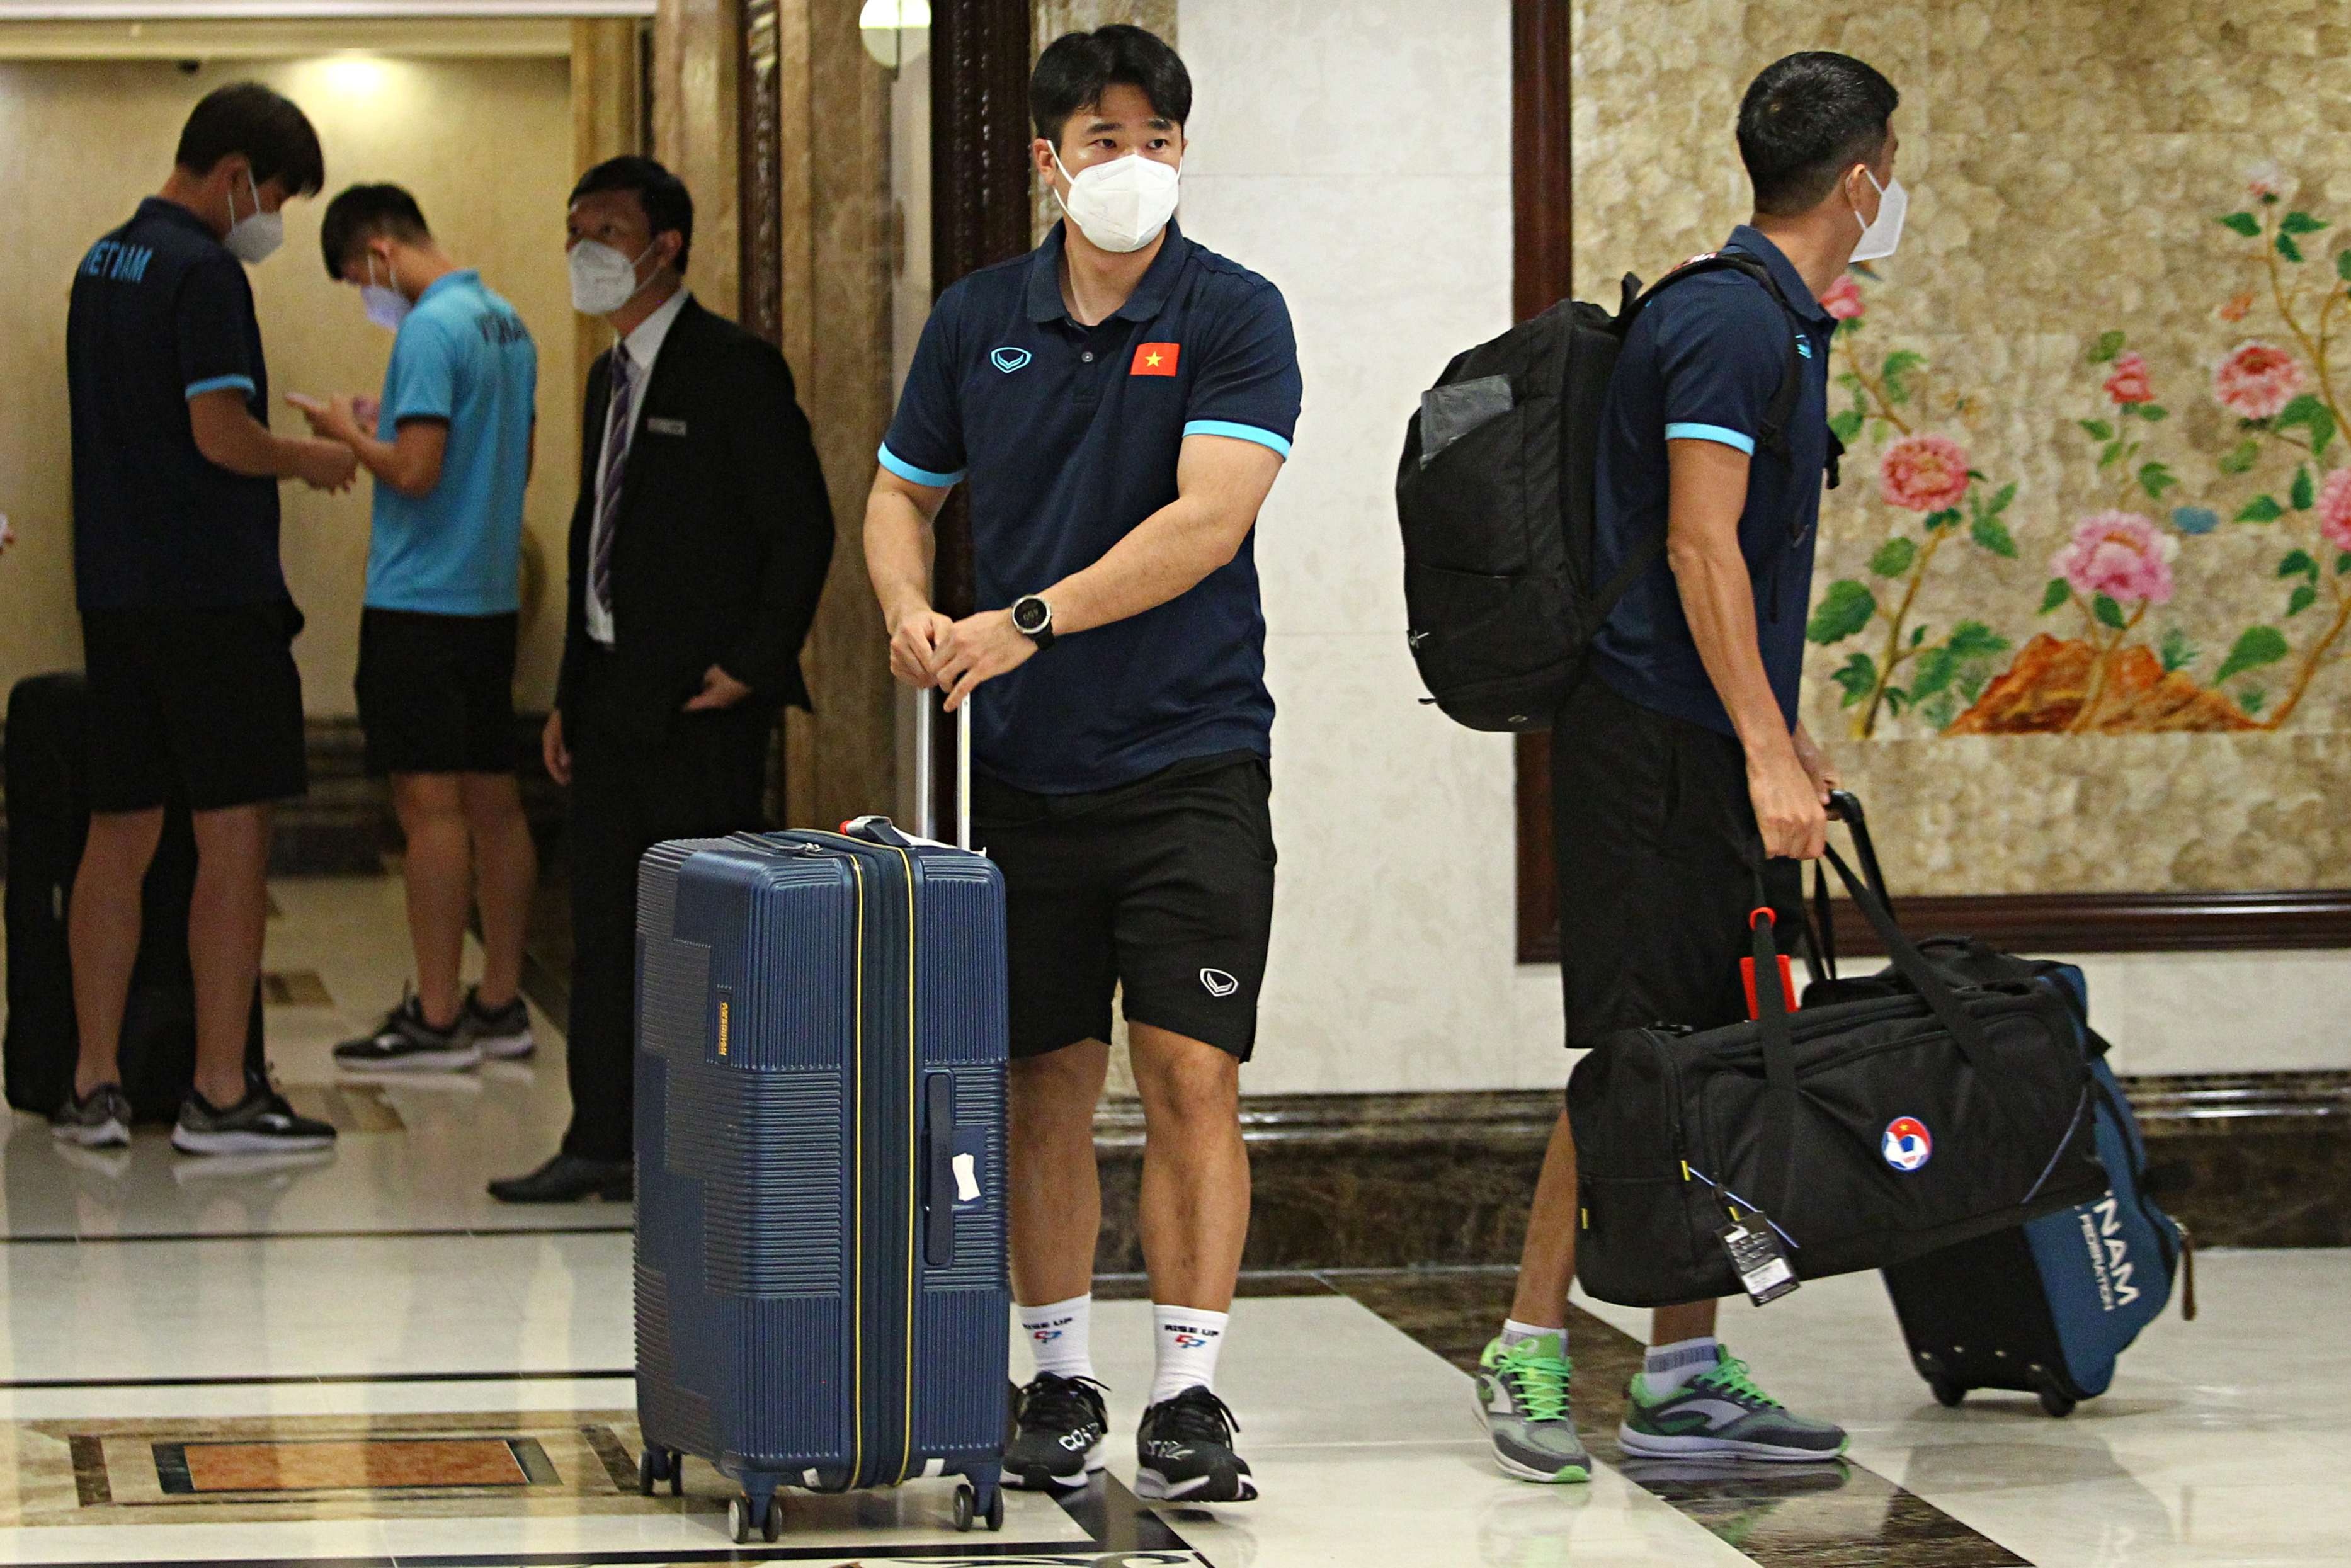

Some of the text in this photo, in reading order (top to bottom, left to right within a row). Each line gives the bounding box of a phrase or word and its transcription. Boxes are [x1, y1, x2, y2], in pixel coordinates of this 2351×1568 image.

[2093, 1190, 2140, 1306] NAM
[1053, 1317, 1073, 1326] UP
[1164, 1324, 1198, 1334] RISE
